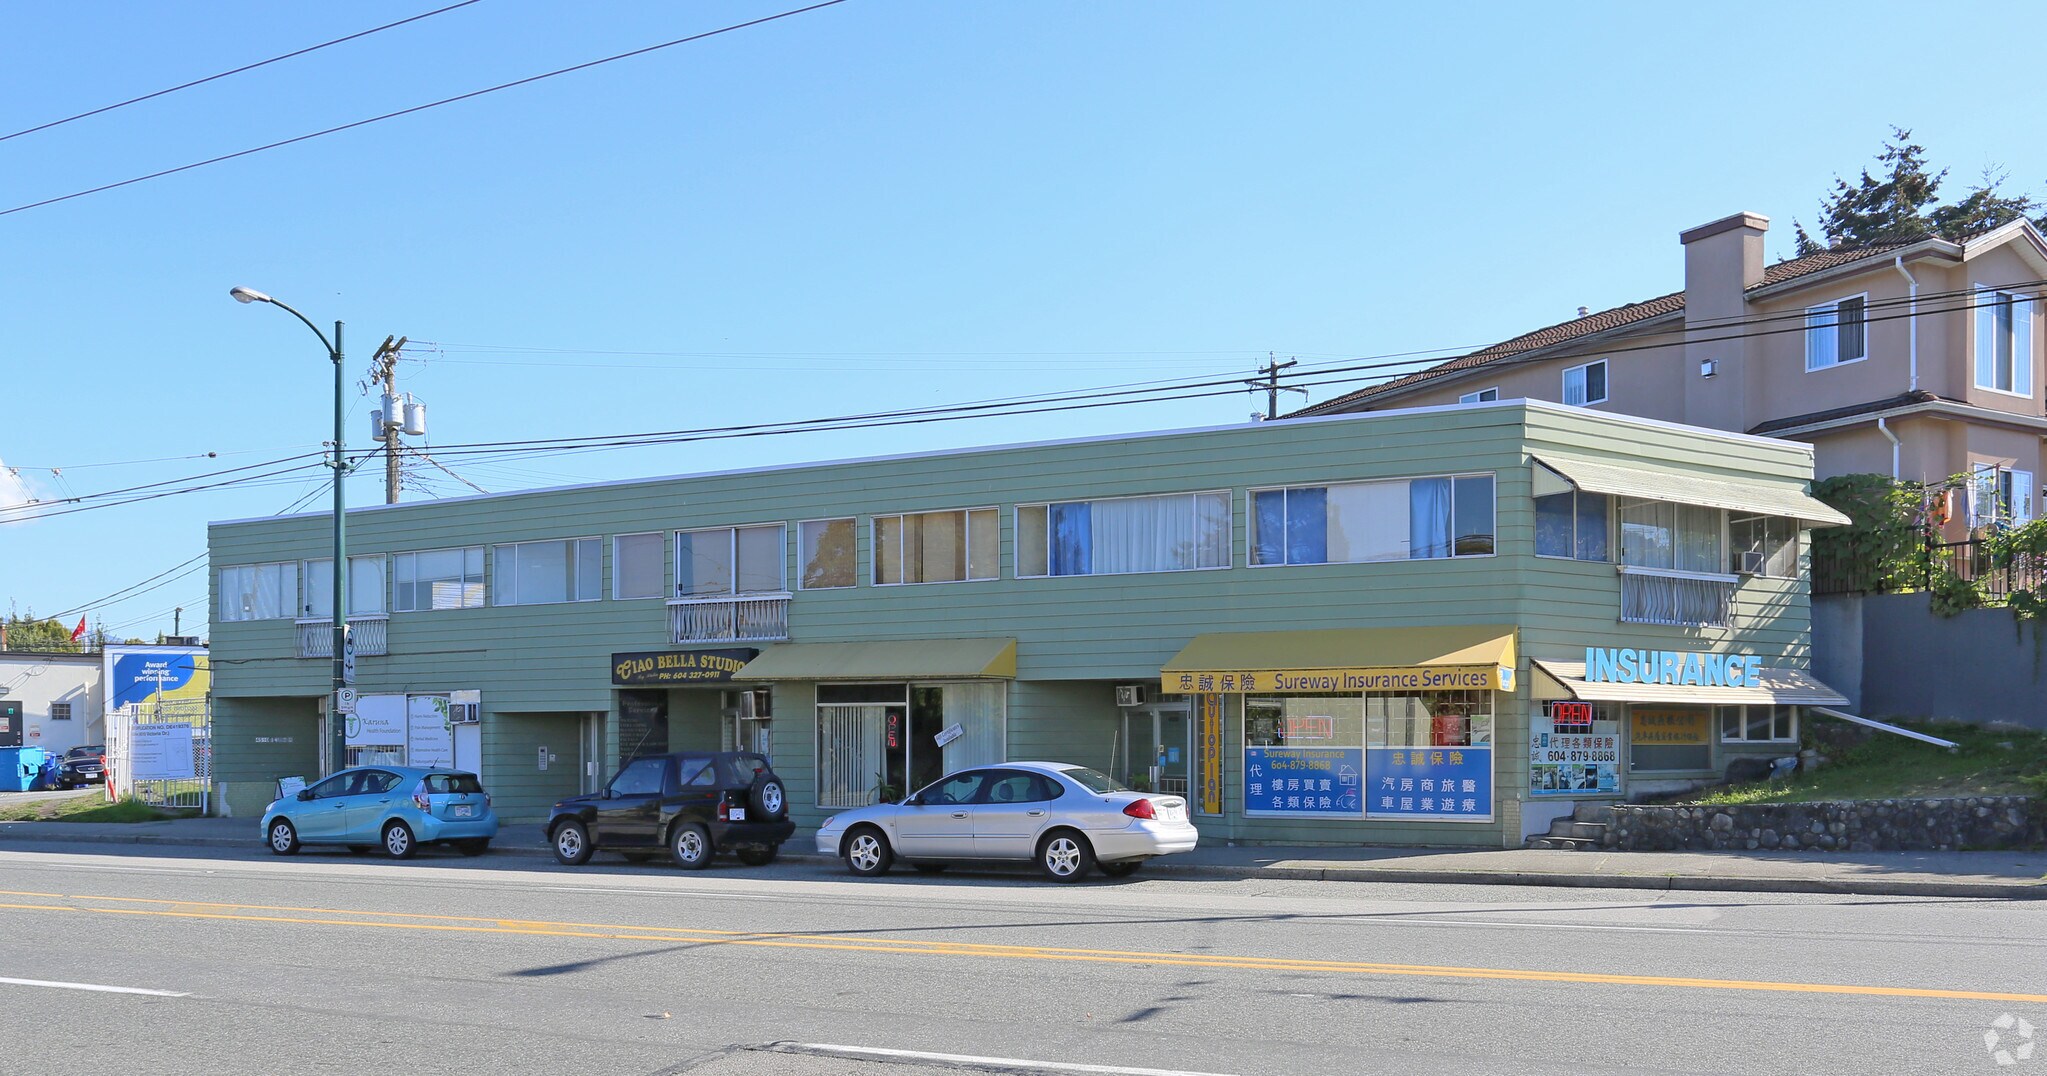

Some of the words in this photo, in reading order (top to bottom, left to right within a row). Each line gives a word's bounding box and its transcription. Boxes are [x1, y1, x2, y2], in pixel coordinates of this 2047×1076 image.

[141, 668, 171, 676] winning
[616, 658, 654, 680] CIAO
[656, 654, 697, 669] BELLA
[1585, 647, 1762, 688] INSURANCE
[134, 675, 179, 683] perforance
[659, 672, 671, 680] PH:
[673, 671, 687, 679] 604
[688, 671, 720, 679] 327-0911
[1179, 673, 1256, 691] 忠誠保險
[1274, 673, 1339, 692] Sureway
[1343, 672, 1418, 689] Insurance
[1422, 668, 1488, 687] Services
[1553, 703, 1591, 725] OPEN
[1549, 737, 1614, 749] 代理各類保險
[1264, 749, 1301, 759] Sureway
[1303, 749, 1345, 758] Insurance
[1392, 751, 1464, 765] 忠誠保險
[1272, 796, 1332, 808] 各類保險
